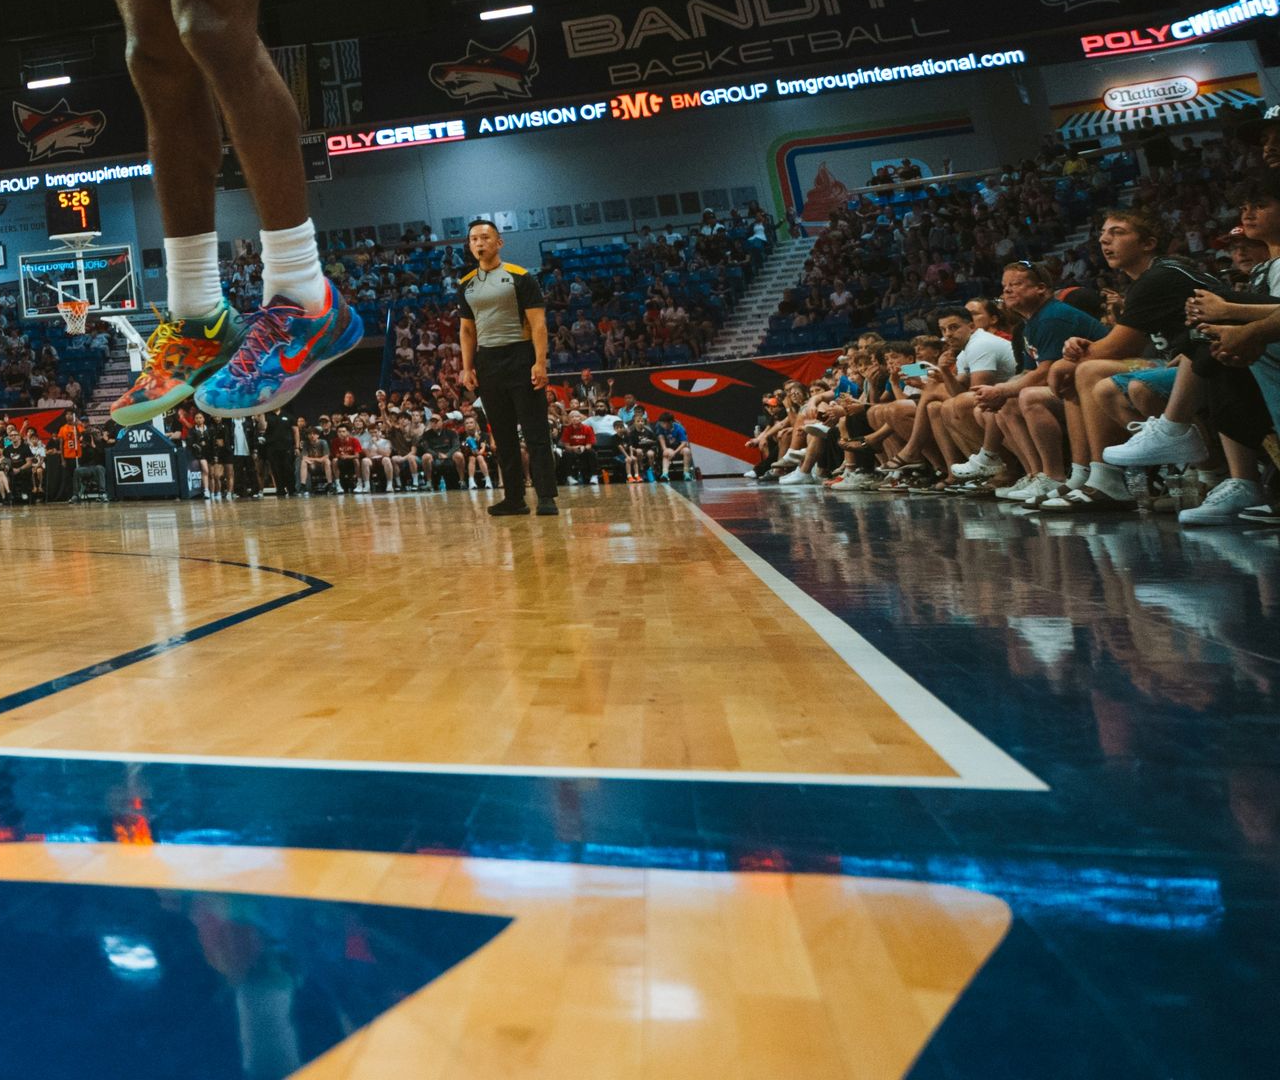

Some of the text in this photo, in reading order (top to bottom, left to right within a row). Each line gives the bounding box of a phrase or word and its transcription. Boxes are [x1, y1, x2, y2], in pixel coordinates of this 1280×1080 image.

[607, 16, 951, 86] BASKETBALL
[478, 117, 494, 134] A
[494, 105, 577, 133] DIVISION
[580, 102, 607, 121] OF
[670, 82, 769, 111] BMGROUP
[776, 47, 1027, 97] bmgroupinternational.com
[1108, 81, 1189, 103] Nathan's
[57, 190, 91, 209] 5:26
[146, 459, 168, 470] NEW
[147, 468, 169, 478] ERA
